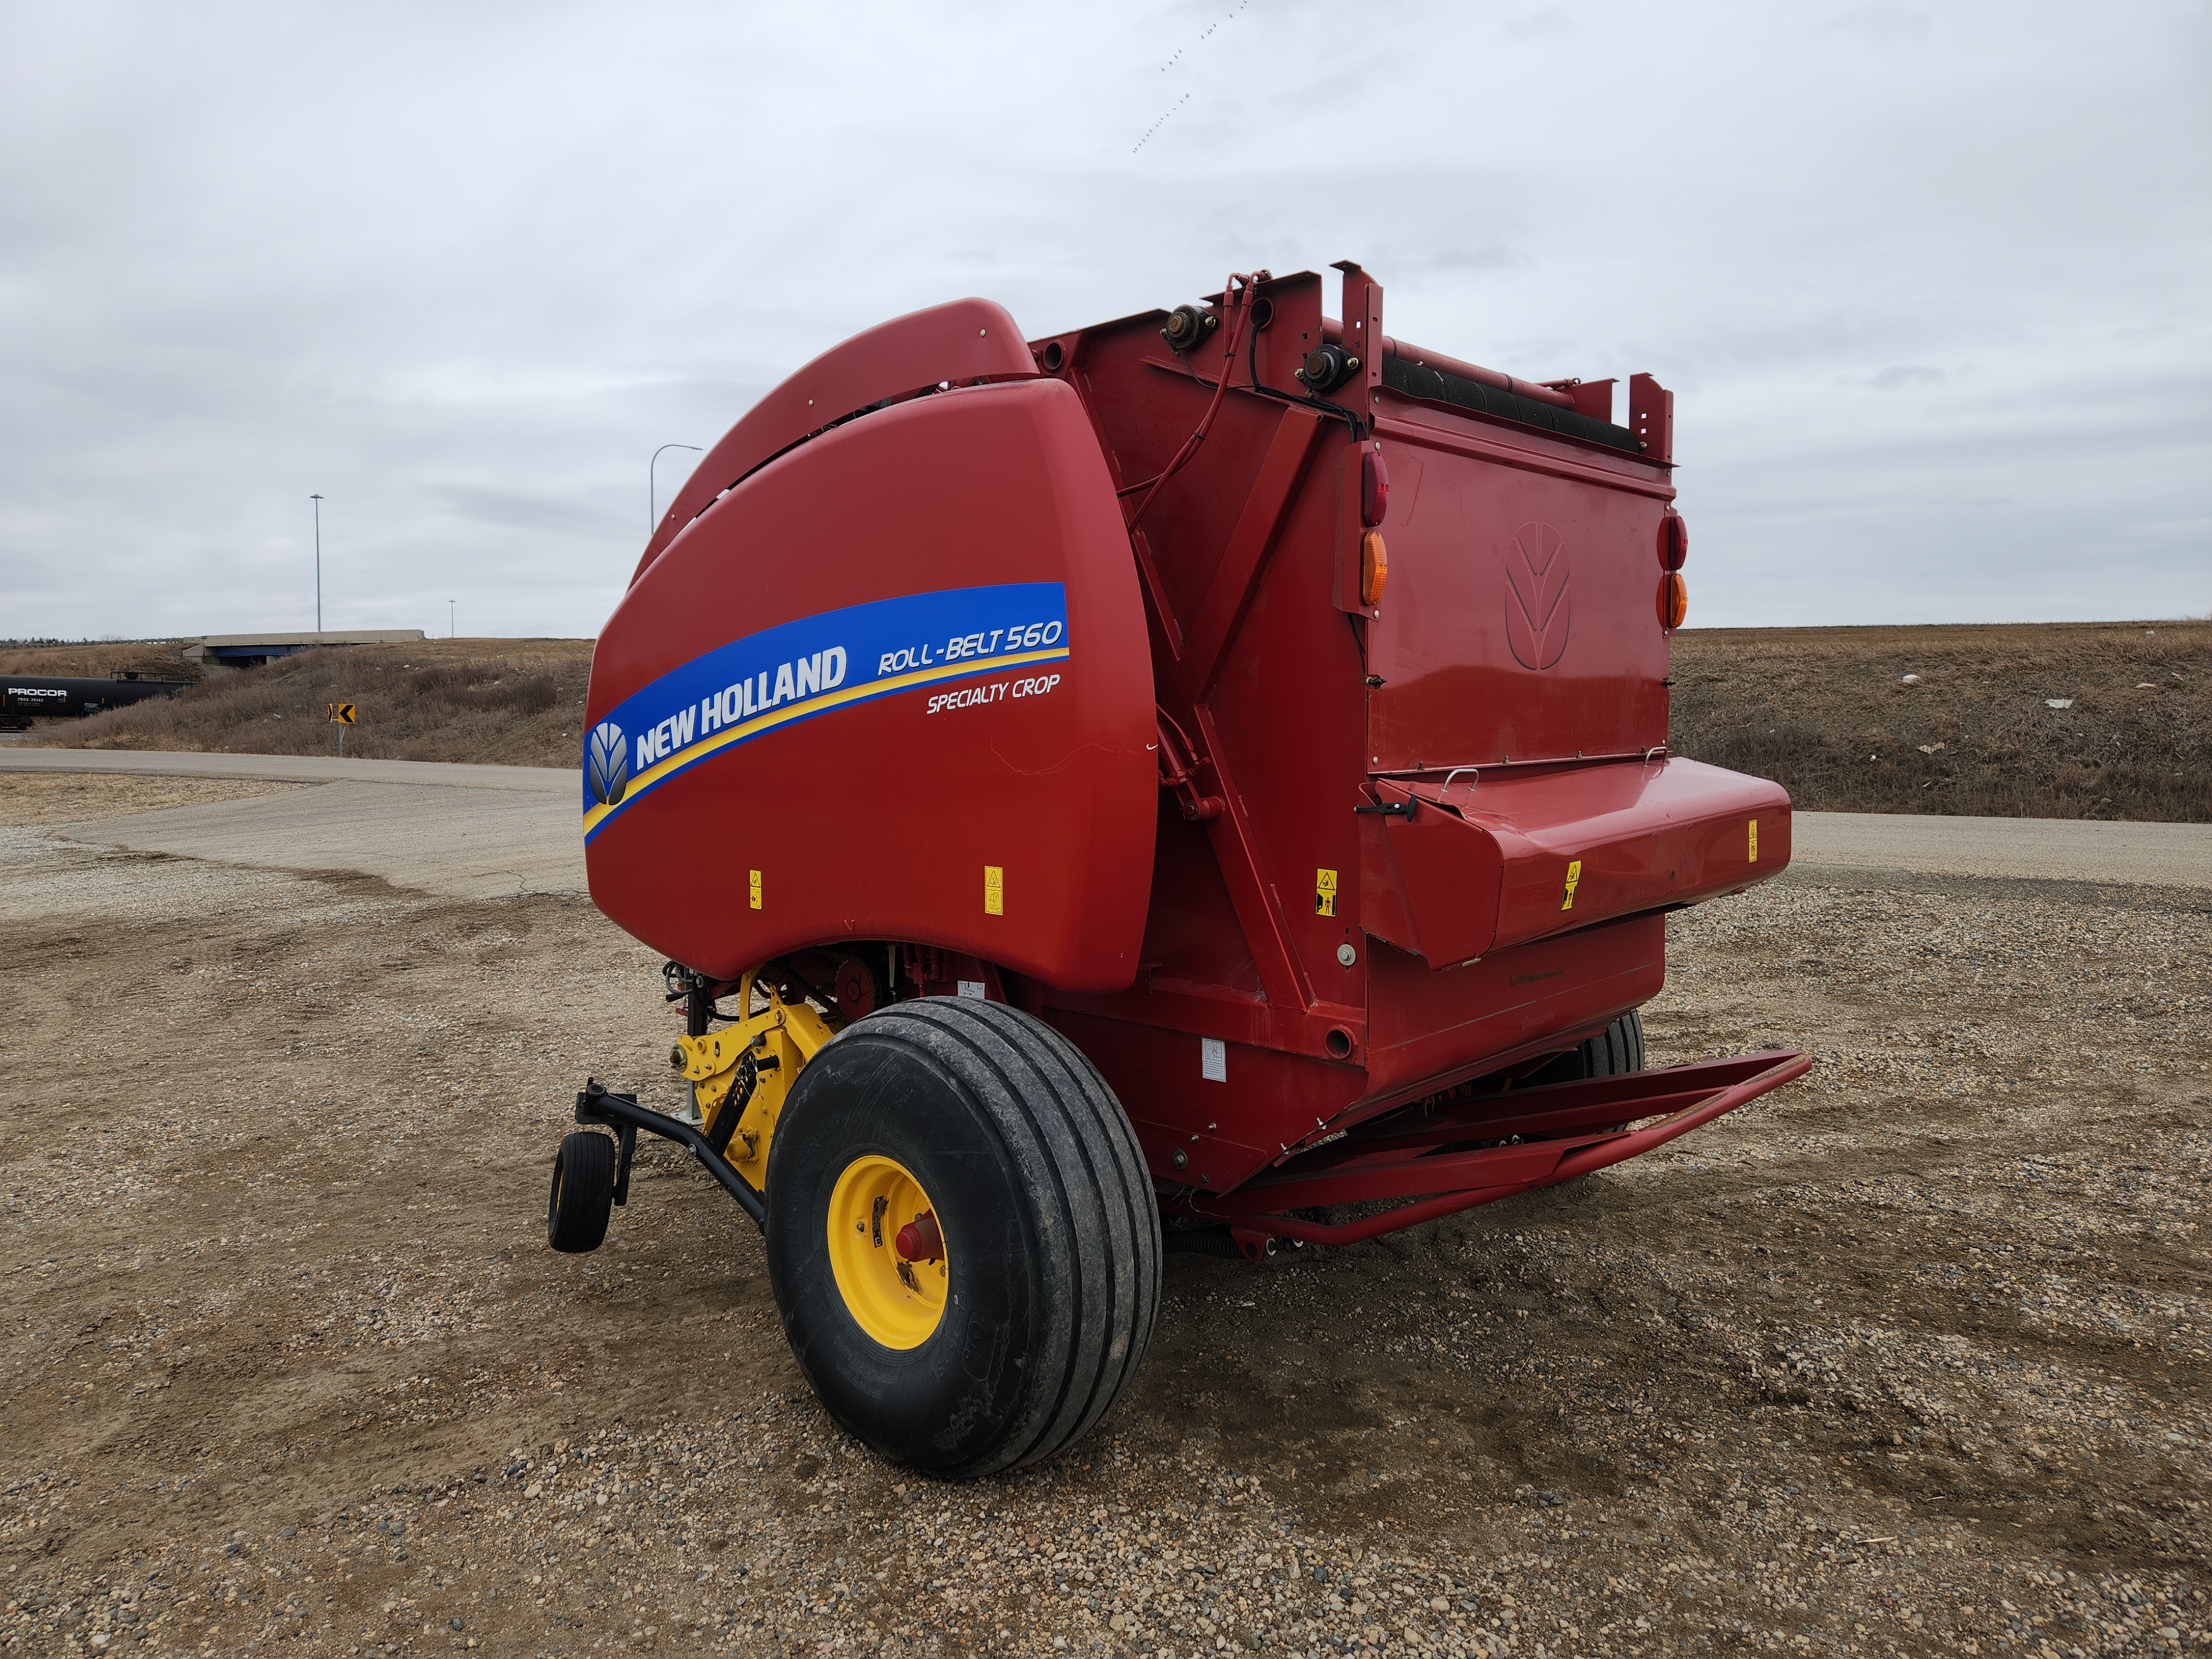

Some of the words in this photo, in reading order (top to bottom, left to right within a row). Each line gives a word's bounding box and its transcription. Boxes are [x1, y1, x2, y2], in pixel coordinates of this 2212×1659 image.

[878, 629, 1004, 675] ROLL-BELT
[1005, 620, 1062, 651] 560
[8, 687, 67, 697] PROCOR
[637, 704, 696, 771] NEW
[701, 646, 847, 735] HOLLAND
[927, 682, 1009, 714] SPECIALTY
[1012, 674, 1060, 698] CROP
